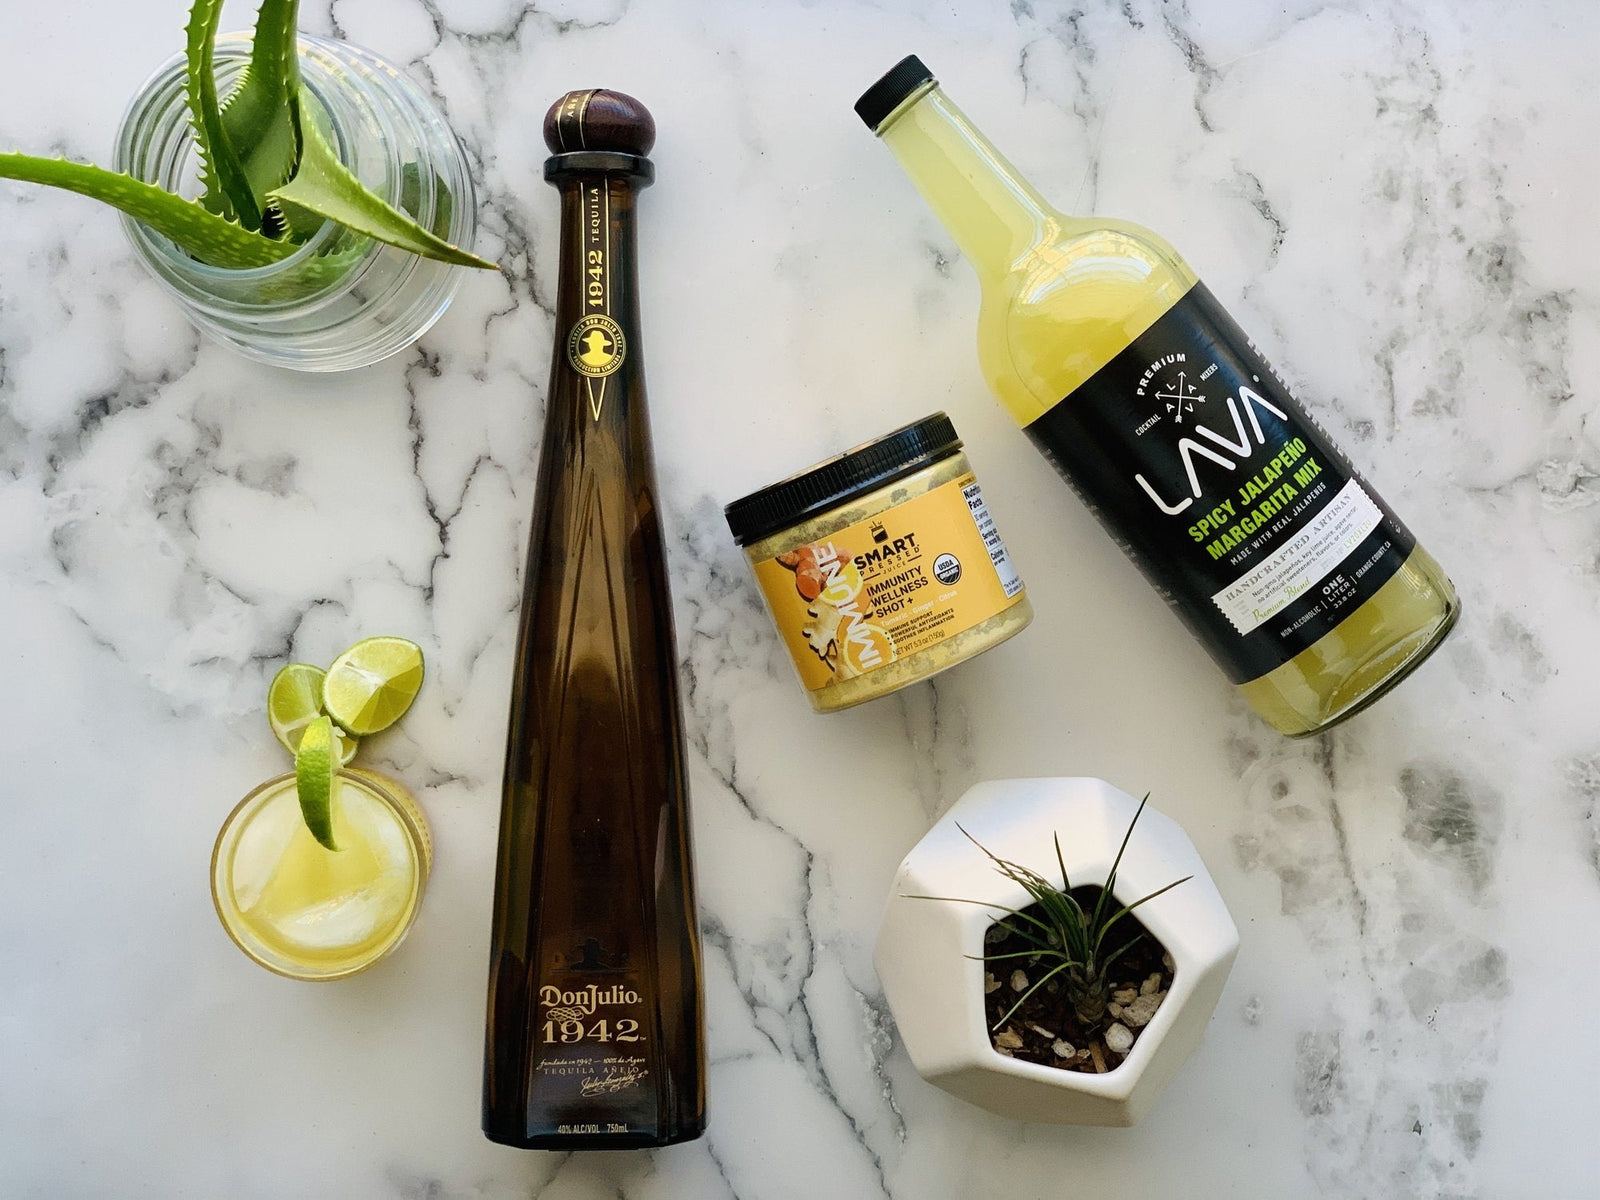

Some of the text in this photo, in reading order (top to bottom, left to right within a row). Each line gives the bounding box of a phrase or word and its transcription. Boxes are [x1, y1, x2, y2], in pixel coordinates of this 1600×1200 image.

[588, 188, 604, 308] 1942 TEQUILA
[1136, 353, 1186, 396] PREMIUM
[1200, 363, 1219, 382] MIXERS
[1135, 413, 1162, 437] COCKTAIL
[1135, 385, 1288, 516] LAVA
[1188, 436, 1307, 542] SPICY JALAPEÑO
[967, 497, 983, 510] Facts
[1206, 482, 1299, 561] MARGARITA
[1293, 457, 1323, 489] MIX
[854, 532, 915, 570] SMART
[1226, 534, 1310, 601] HANDCRAFTED
[1314, 494, 1352, 535] ARTISAN
[1230, 548, 1252, 566] MADE
[1251, 530, 1273, 549] WITH
[1272, 515, 1292, 533] REAL
[859, 546, 920, 577] PRESSED
[882, 560, 906, 575] JUICE
[937, 559, 954, 572] USDA
[1252, 578, 1277, 597] Non-gmo
[1302, 550, 1312, 560] key
[1311, 539, 1323, 552] lime
[1355, 559, 1374, 578] ORANGE
[866, 565, 922, 597] IMMUNITY
[870, 576, 929, 608] WELLNESS
[1257, 596, 1265, 604] no
[1264, 580, 1287, 601] artificial
[1283, 576, 1311, 599] Blend
[1322, 574, 1345, 596] ONE
[1327, 581, 1351, 602] LITER
[812, 541, 883, 669] IMMUNE
[876, 599, 905, 619] SHOT
[889, 611, 933, 633] IMMUNE SUPPORT
[891, 608, 954, 639] POWERFUL ANTIOXIDANTS
[893, 614, 955, 644] SOOTHES INFLAMMATION
[1280, 605, 1322, 638] NON-ALCOHOLIC
[893, 646, 904, 657] NET
[904, 644, 914, 652] WT
[542, 1018, 639, 1043] 1942
[543, 1067, 595, 1076] TEQUILA
[602, 1065, 640, 1076] AÑEJO
[617, 1056, 625, 1064] de
[558, 1123, 629, 1134] 40% ALC/VOL 750mL
